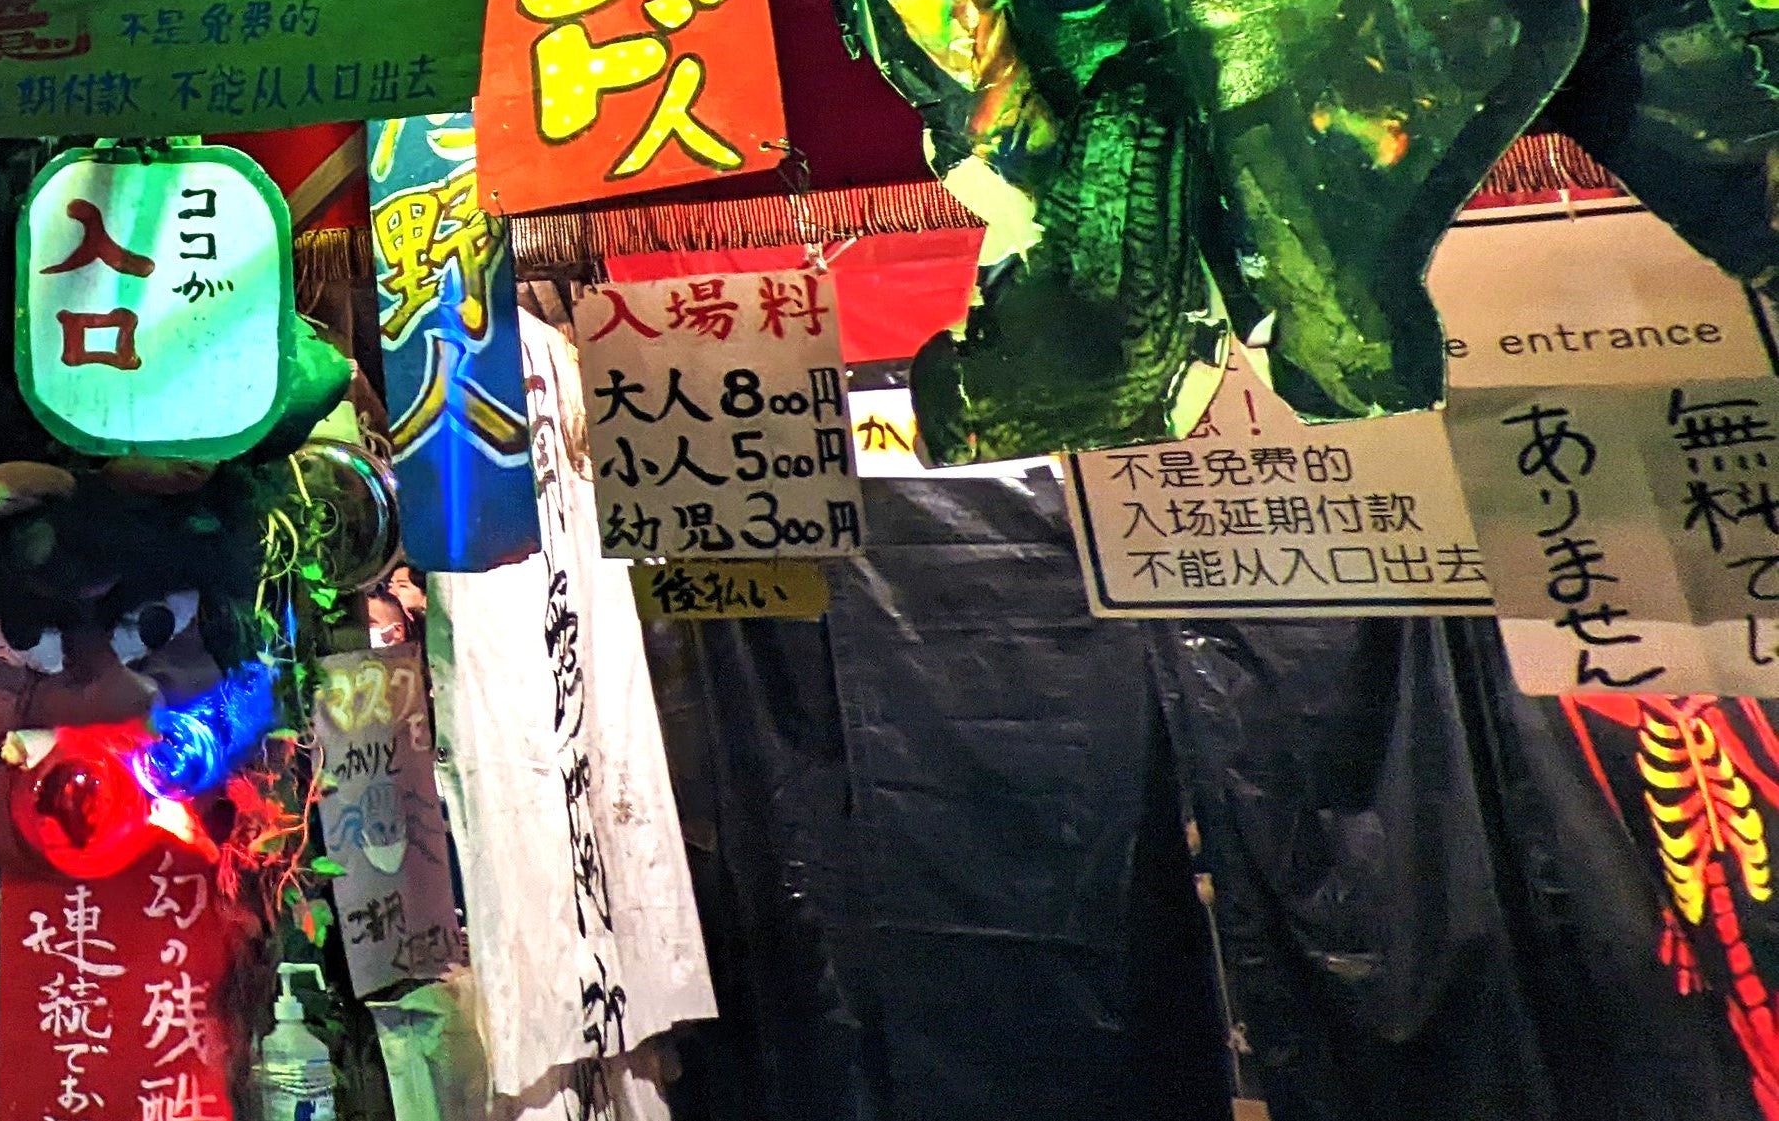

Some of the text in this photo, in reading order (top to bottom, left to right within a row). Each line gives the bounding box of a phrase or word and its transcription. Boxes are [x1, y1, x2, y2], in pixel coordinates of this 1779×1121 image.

[171, 187, 235, 304] ココが
[39, 198, 157, 371] 入口
[588, 273, 830, 341] 入場料
[1499, 322, 1722, 356] entrance
[1110, 444, 1353, 490] 不是免费的
[1123, 492, 1424, 537] 入场延期付款
[1501, 403, 1667, 688] ありません
[1127, 543, 1489, 589] 不能从入口出去
[22, 884, 126, 1121] 連続でお
